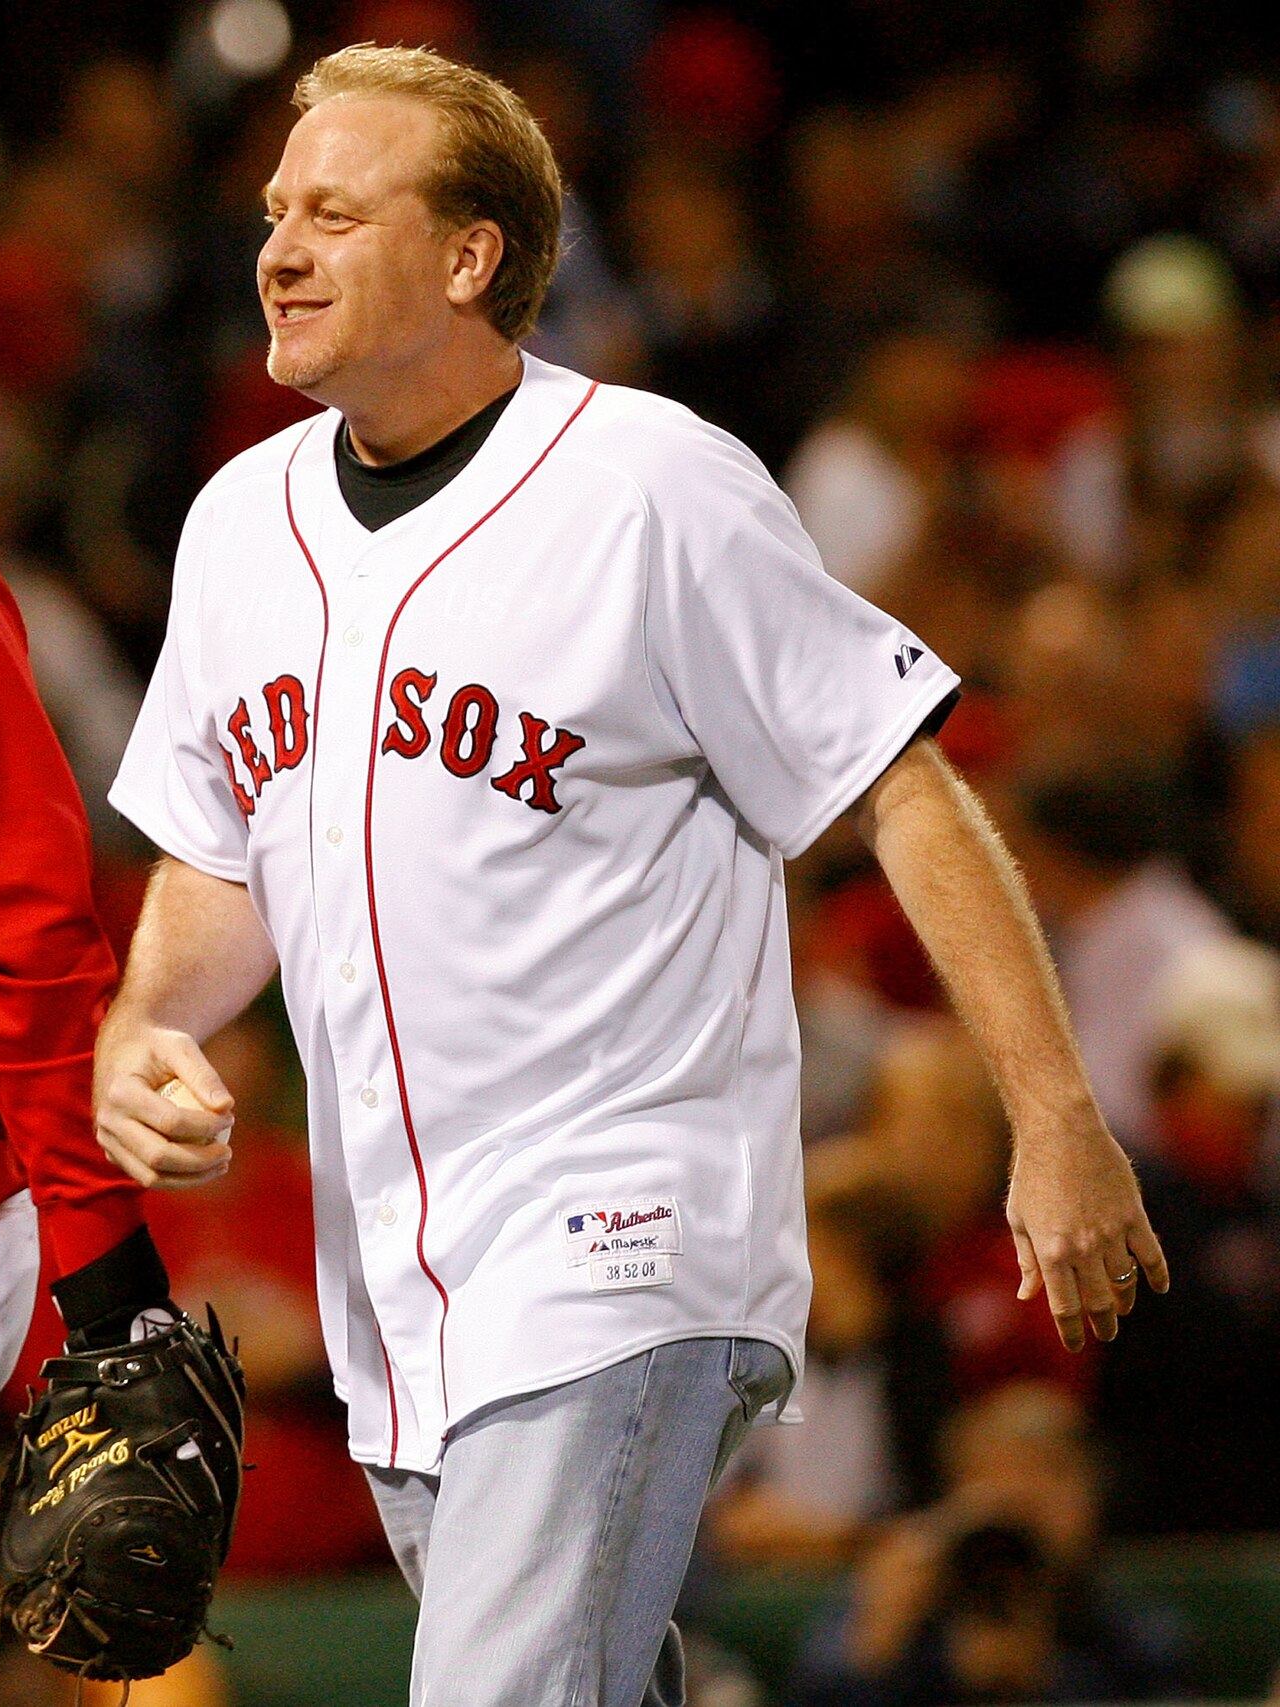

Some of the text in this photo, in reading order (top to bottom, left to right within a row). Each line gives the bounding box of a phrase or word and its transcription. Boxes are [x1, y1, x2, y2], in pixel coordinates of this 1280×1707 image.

[381, 667, 586, 814] SOX
[604, 1204, 673, 1234] Authentic
[611, 1237, 657, 1250] Majestic
[606, 1261, 656, 1280] 38 52 08
[68, 1437, 130, 1493] David
